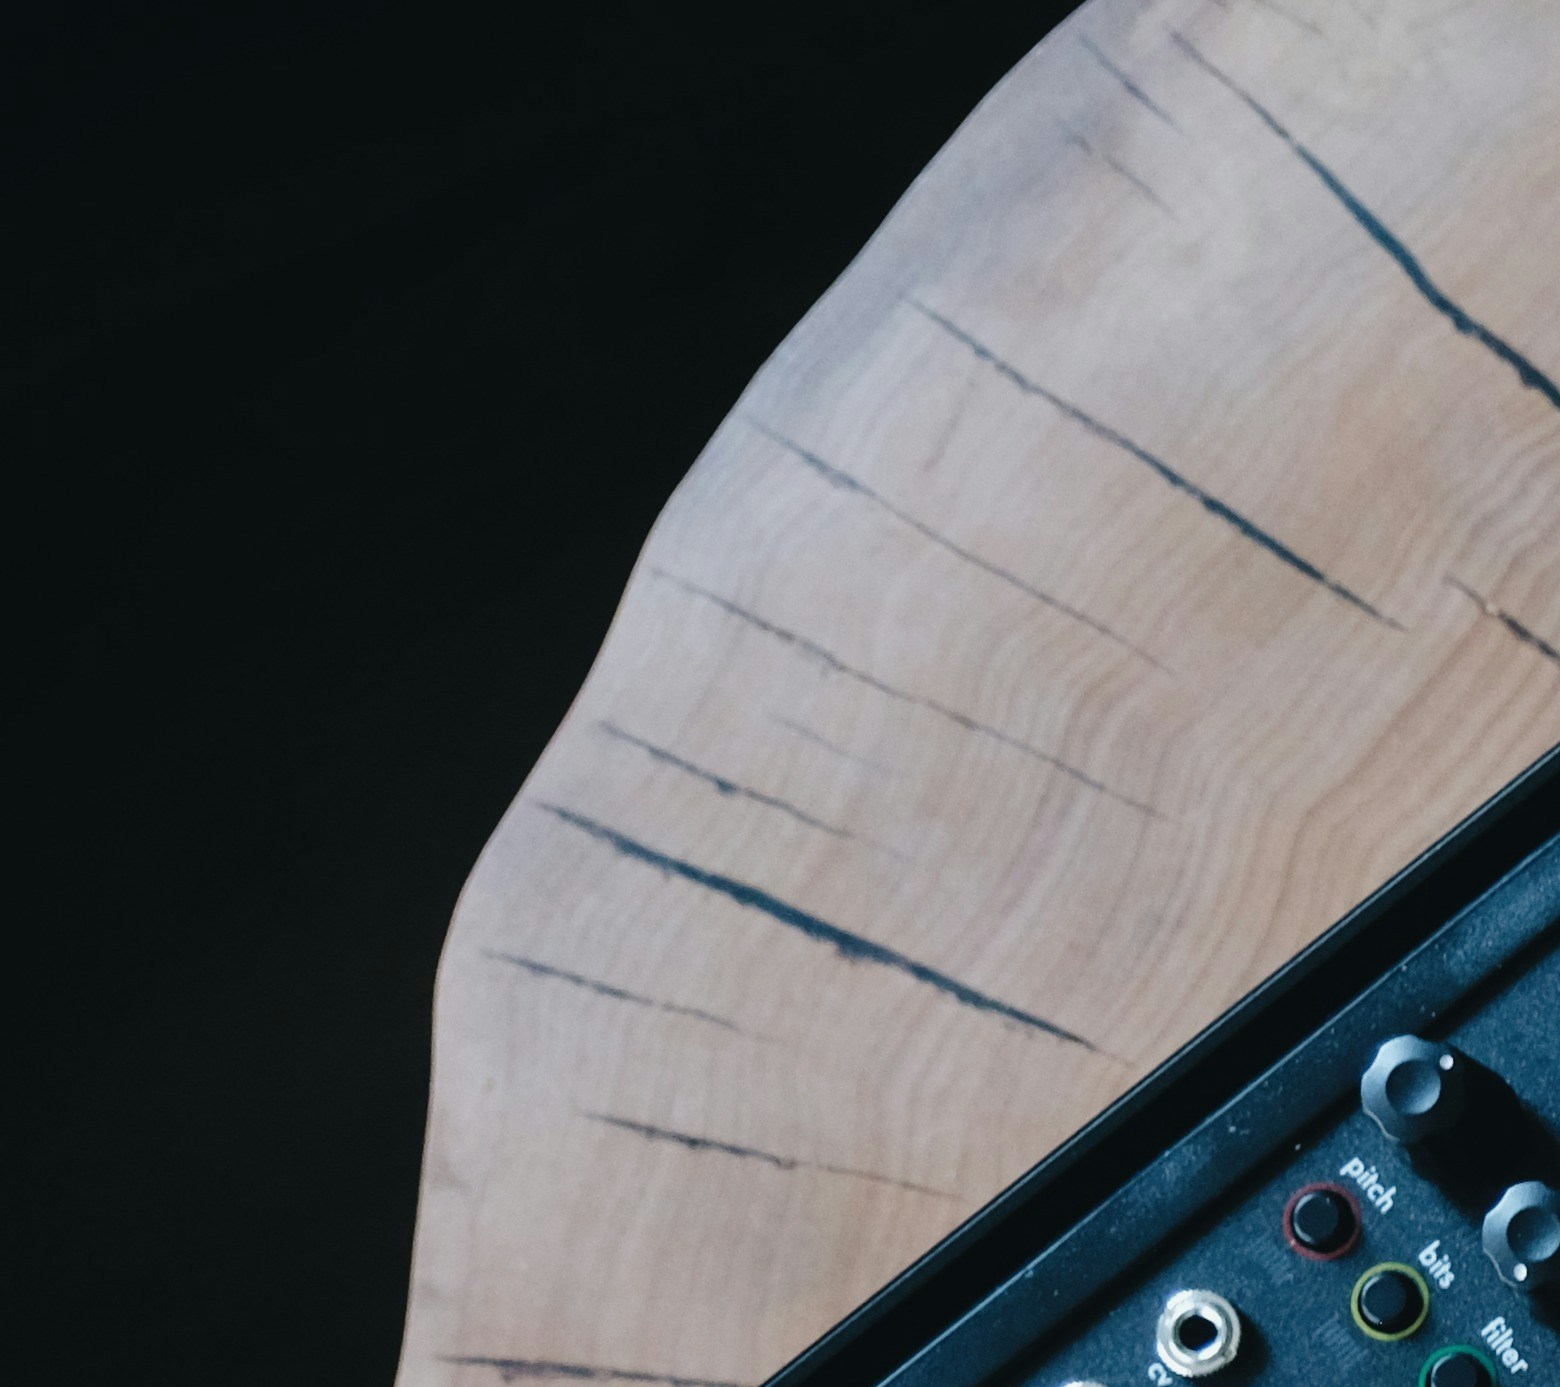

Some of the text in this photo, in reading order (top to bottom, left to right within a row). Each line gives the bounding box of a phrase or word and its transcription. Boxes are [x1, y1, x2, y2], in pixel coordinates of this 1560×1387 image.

[1337, 1155, 1398, 1216] pitch
[1415, 1238, 1456, 1291] bits
[1478, 1314, 1529, 1376] filter
